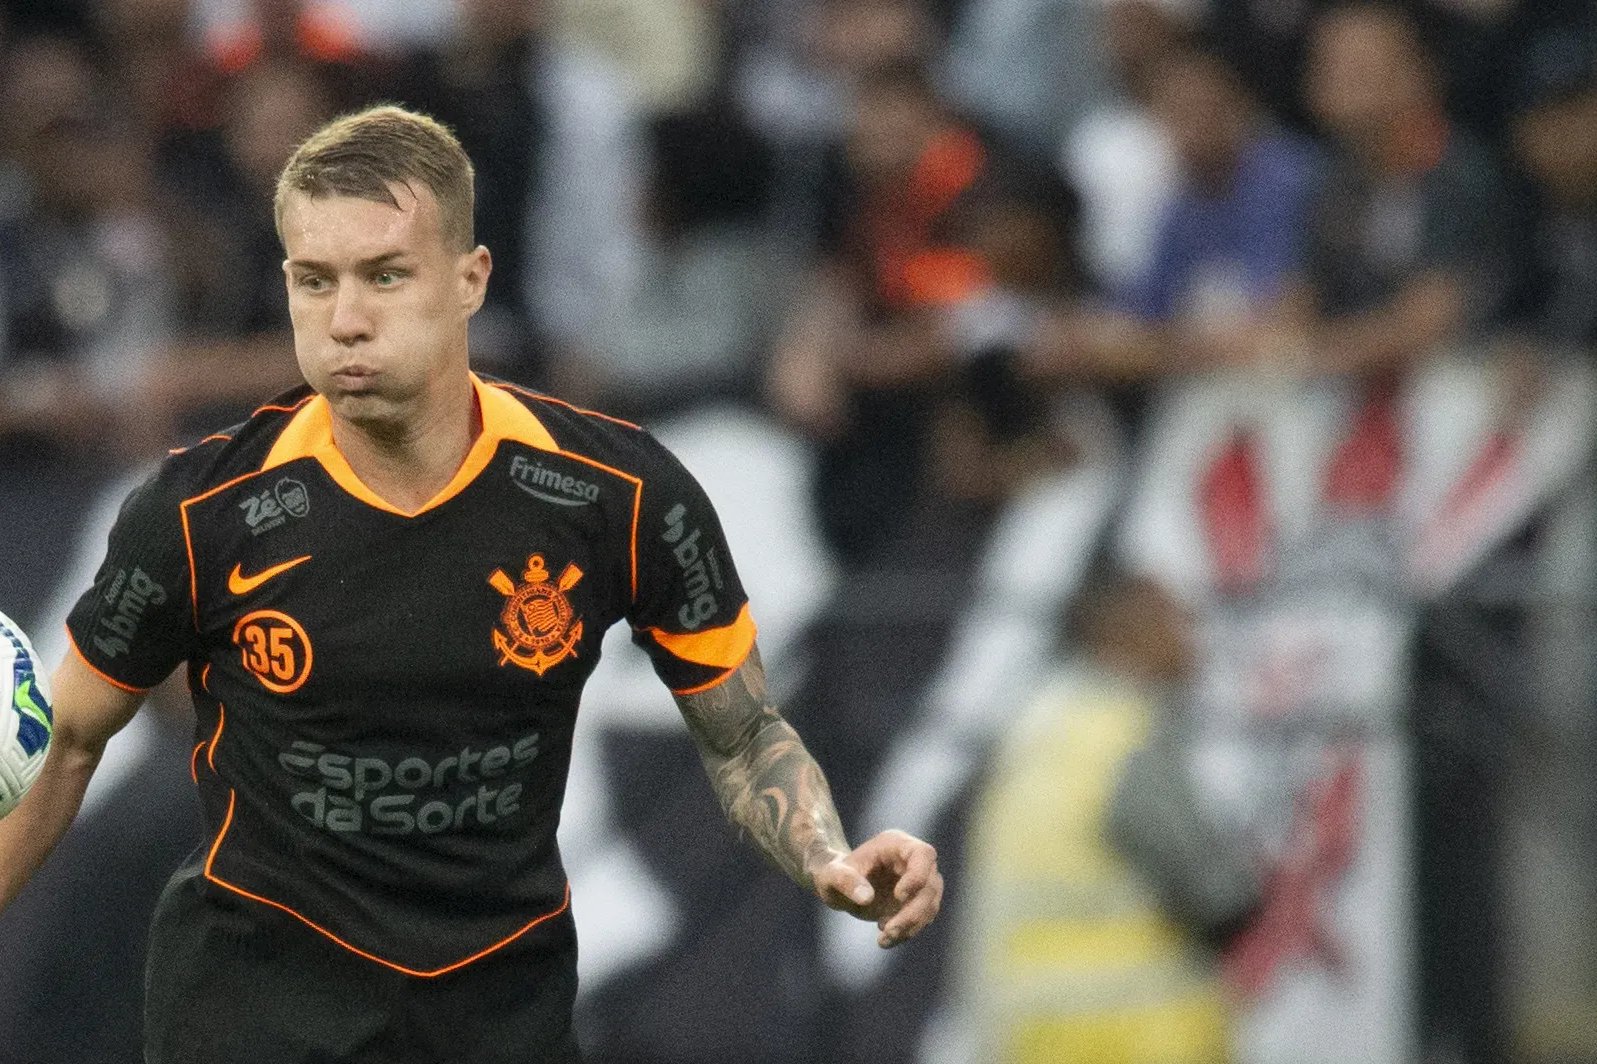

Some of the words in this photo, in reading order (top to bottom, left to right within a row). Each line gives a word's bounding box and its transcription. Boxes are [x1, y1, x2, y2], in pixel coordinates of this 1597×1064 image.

[239, 489, 283, 527] Zé
[510, 455, 600, 504] Frimesa
[100, 564, 168, 640] bmg
[673, 528, 718, 629] bmg
[244, 625, 295, 680] 35
[277, 732, 540, 801] Esportes
